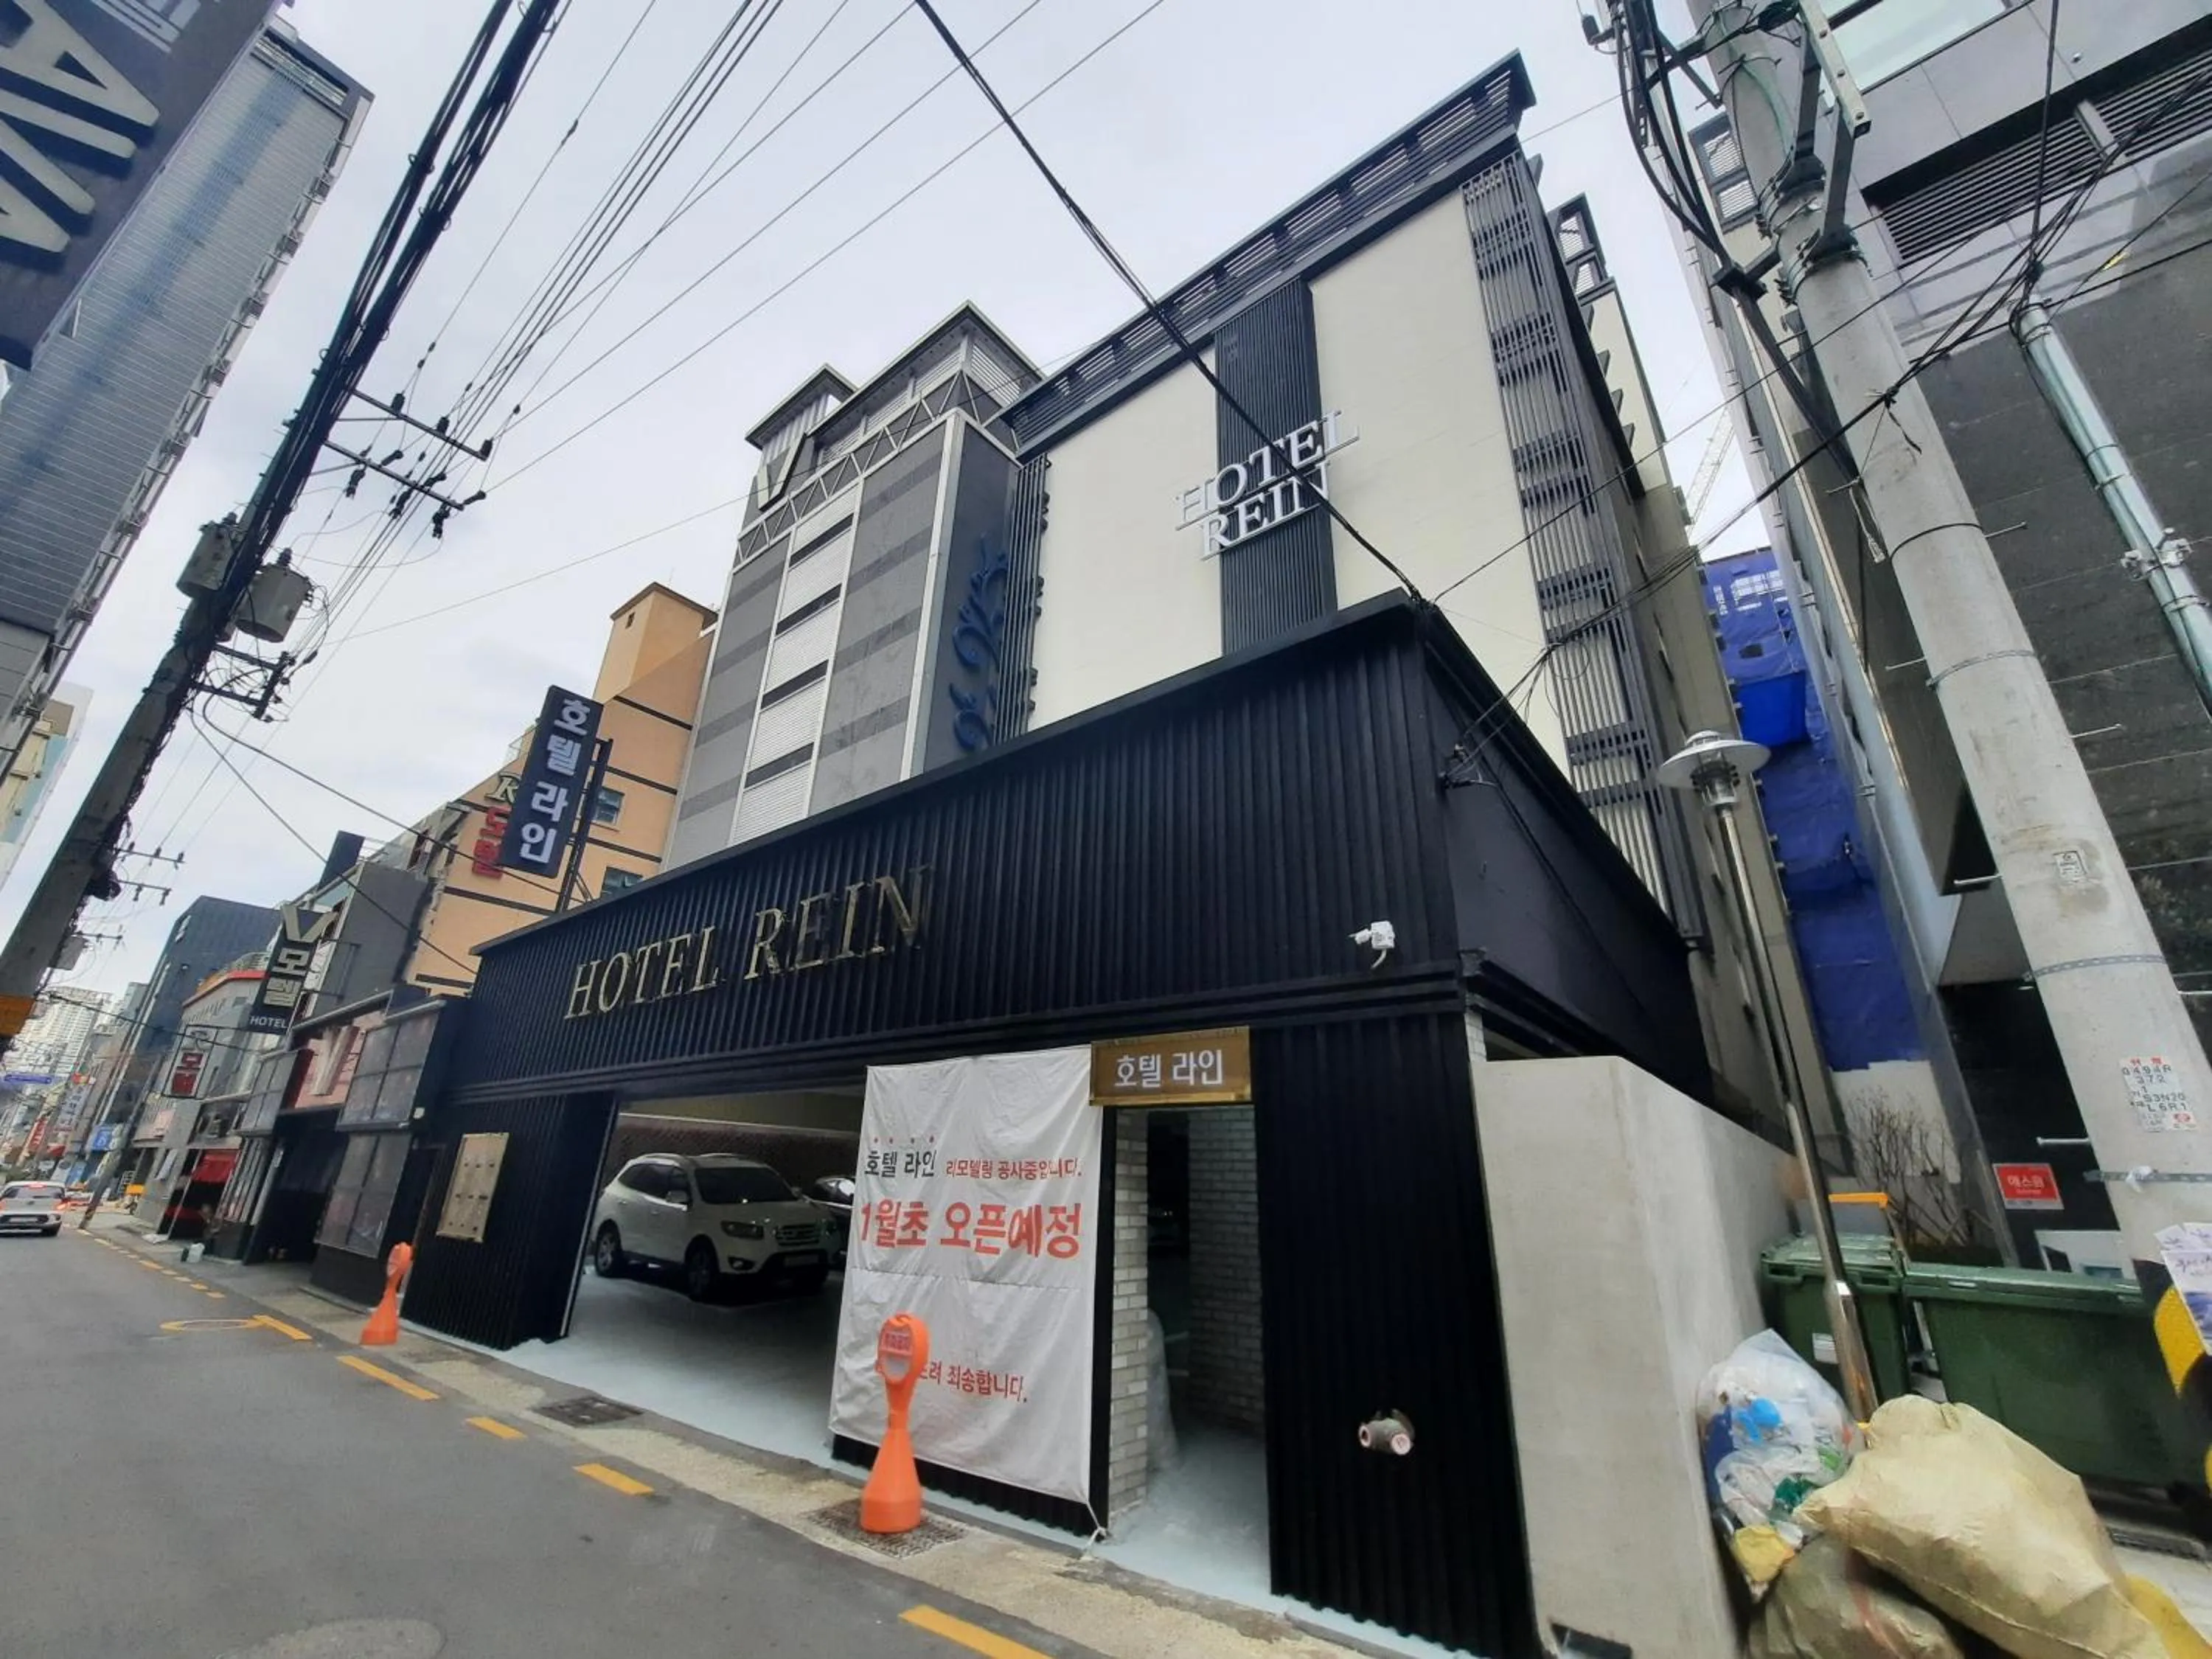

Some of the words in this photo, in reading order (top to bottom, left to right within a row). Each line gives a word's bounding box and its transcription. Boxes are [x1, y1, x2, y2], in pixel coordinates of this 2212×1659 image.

[1175, 410, 1360, 532] HOTEL
[1200, 459, 1331, 562] REIN
[546, 698, 591, 776] 호텔
[519, 781, 569, 864] 라인
[563, 925, 723, 1020] HOTEL
[744, 861, 933, 981] REIN
[249, 1015, 288, 1029] HOTEL
[1114, 1054, 1161, 1088] 호텔
[1172, 1048, 1223, 1086] 라인
[864, 1150, 897, 1178] 호텔
[904, 1150, 937, 1178] 라인
[997, 1157, 1082, 1180] 공사중입니다.
[860, 1199, 929, 1248] 1월초
[940, 1202, 1082, 1259] 오픈예정
[946, 1365, 1027, 1403] 죄송합니다.
